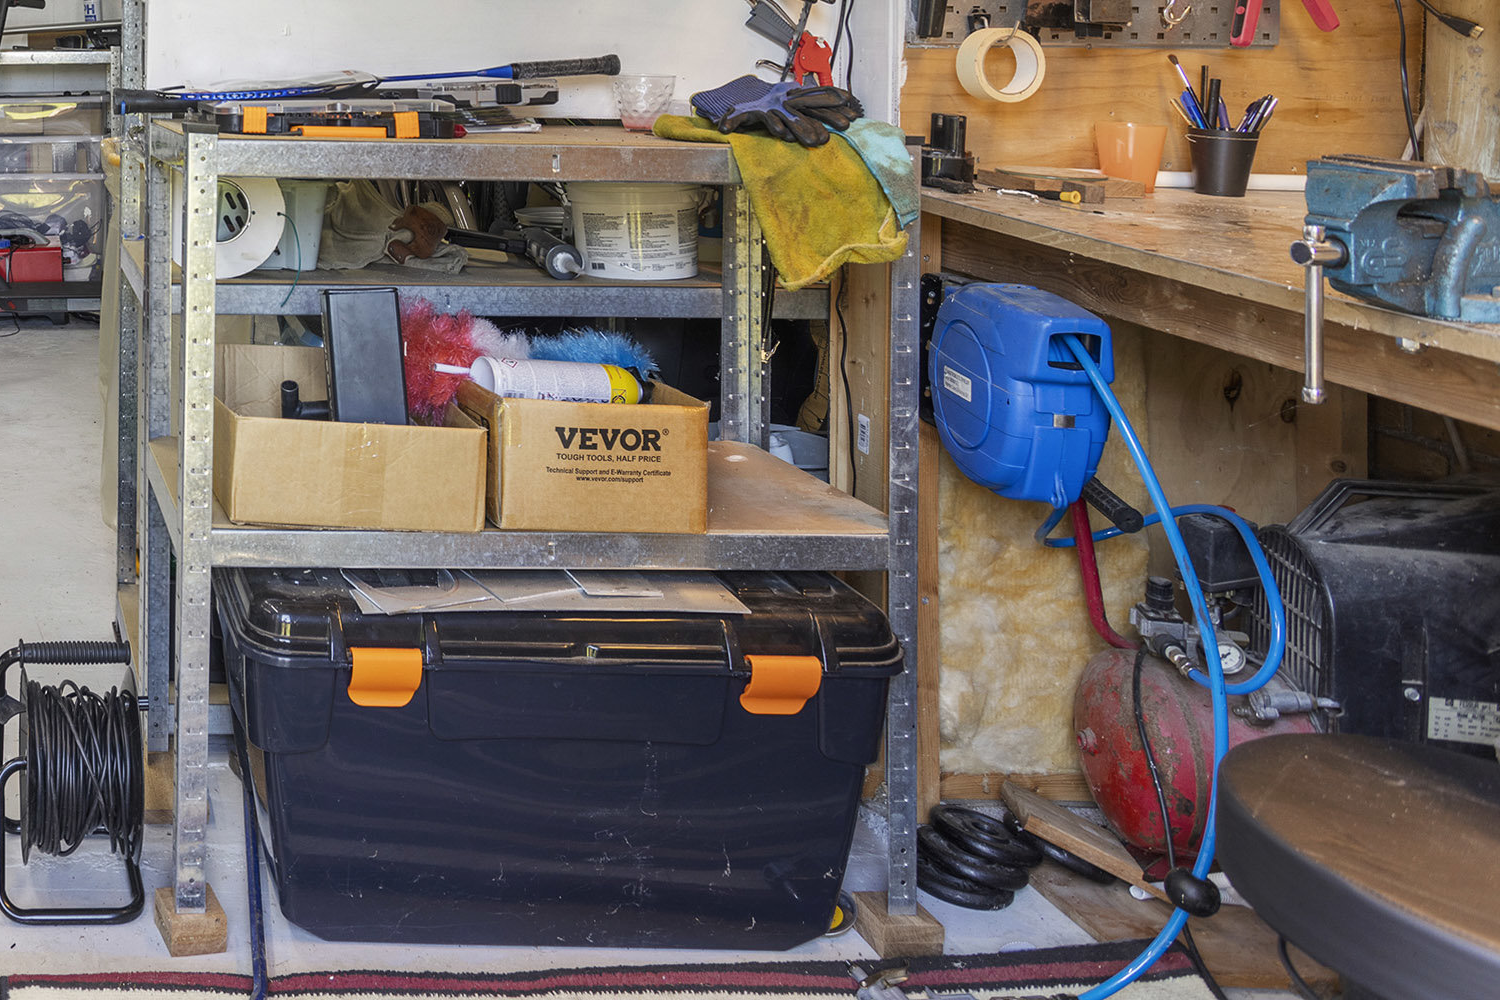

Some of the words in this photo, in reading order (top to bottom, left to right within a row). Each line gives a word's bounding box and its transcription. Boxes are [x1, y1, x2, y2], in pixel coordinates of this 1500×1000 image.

[555, 426, 661, 452] VEVOR
[556, 453, 585, 461] TOUGH
[586, 454, 615, 462] TOOLS,
[638, 455, 661, 463] PRICE
[546, 466, 574, 474] Technical
[575, 468, 598, 476] Support
[611, 468, 642, 477] E-Warranty
